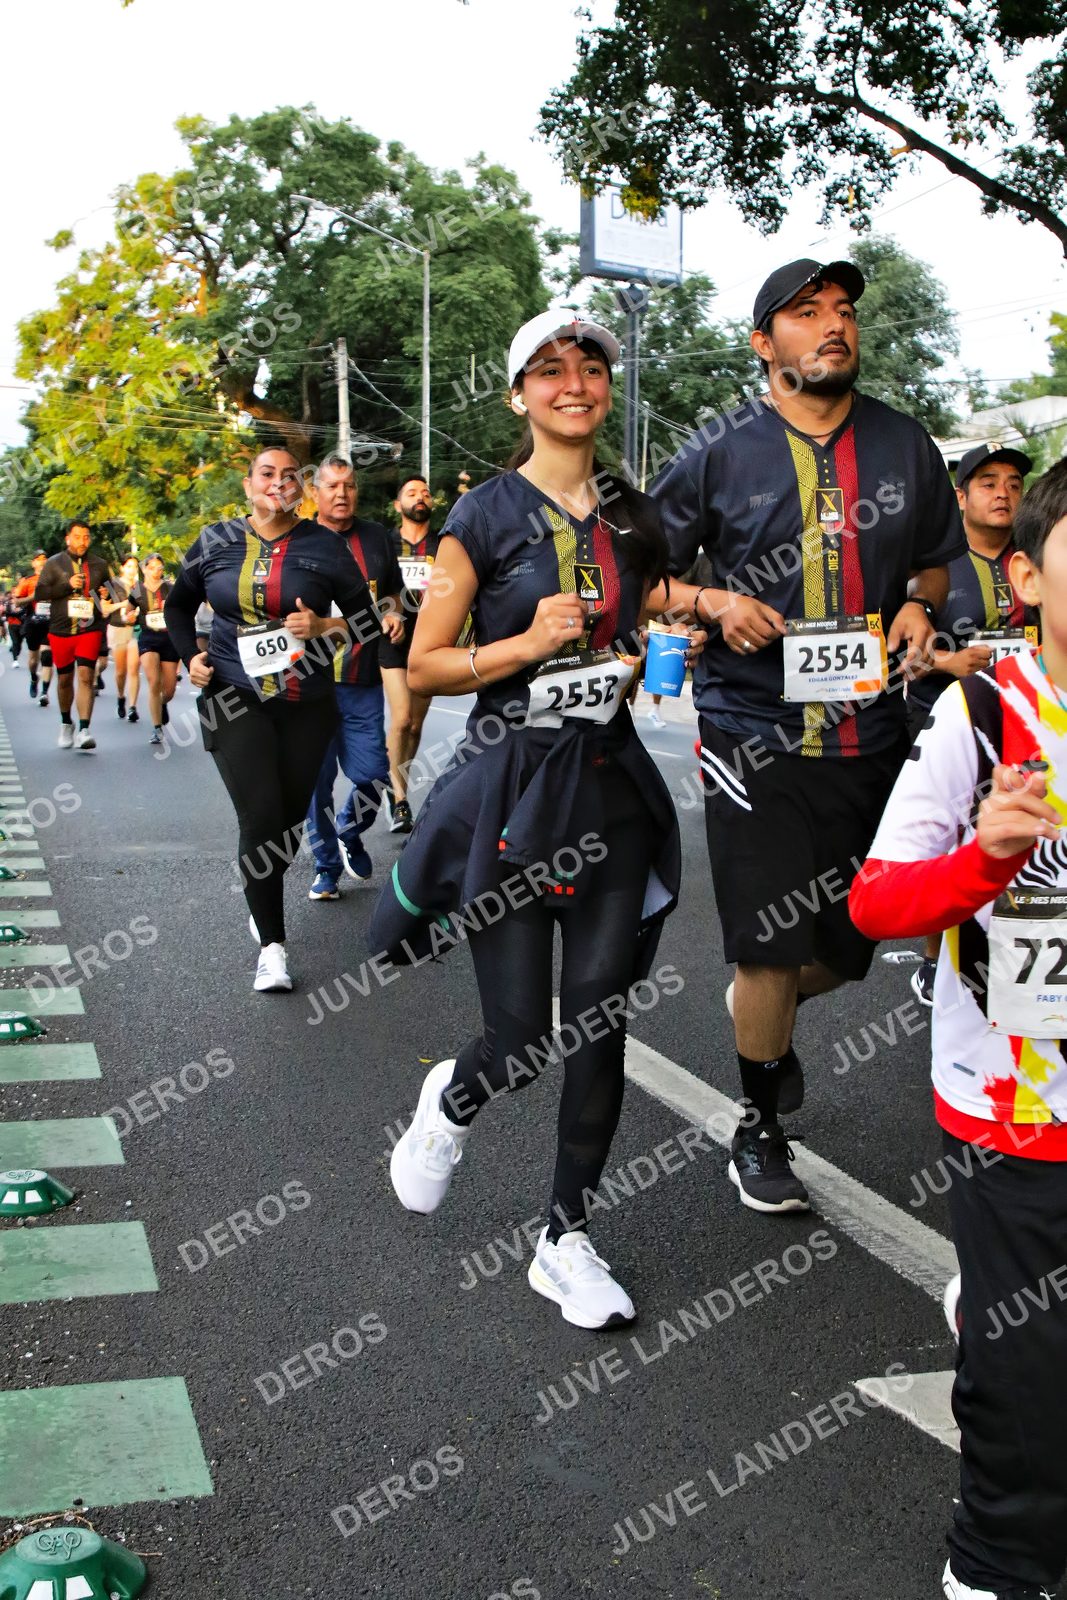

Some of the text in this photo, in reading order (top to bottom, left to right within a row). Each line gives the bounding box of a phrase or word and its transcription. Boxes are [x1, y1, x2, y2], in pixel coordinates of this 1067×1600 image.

[255, 635, 288, 657] 650
[798, 643, 868, 674] 2554
[545, 674, 619, 711] 2552
[1014, 937, 1067, 985] 72
[1036, 994, 1061, 1003] FABY
